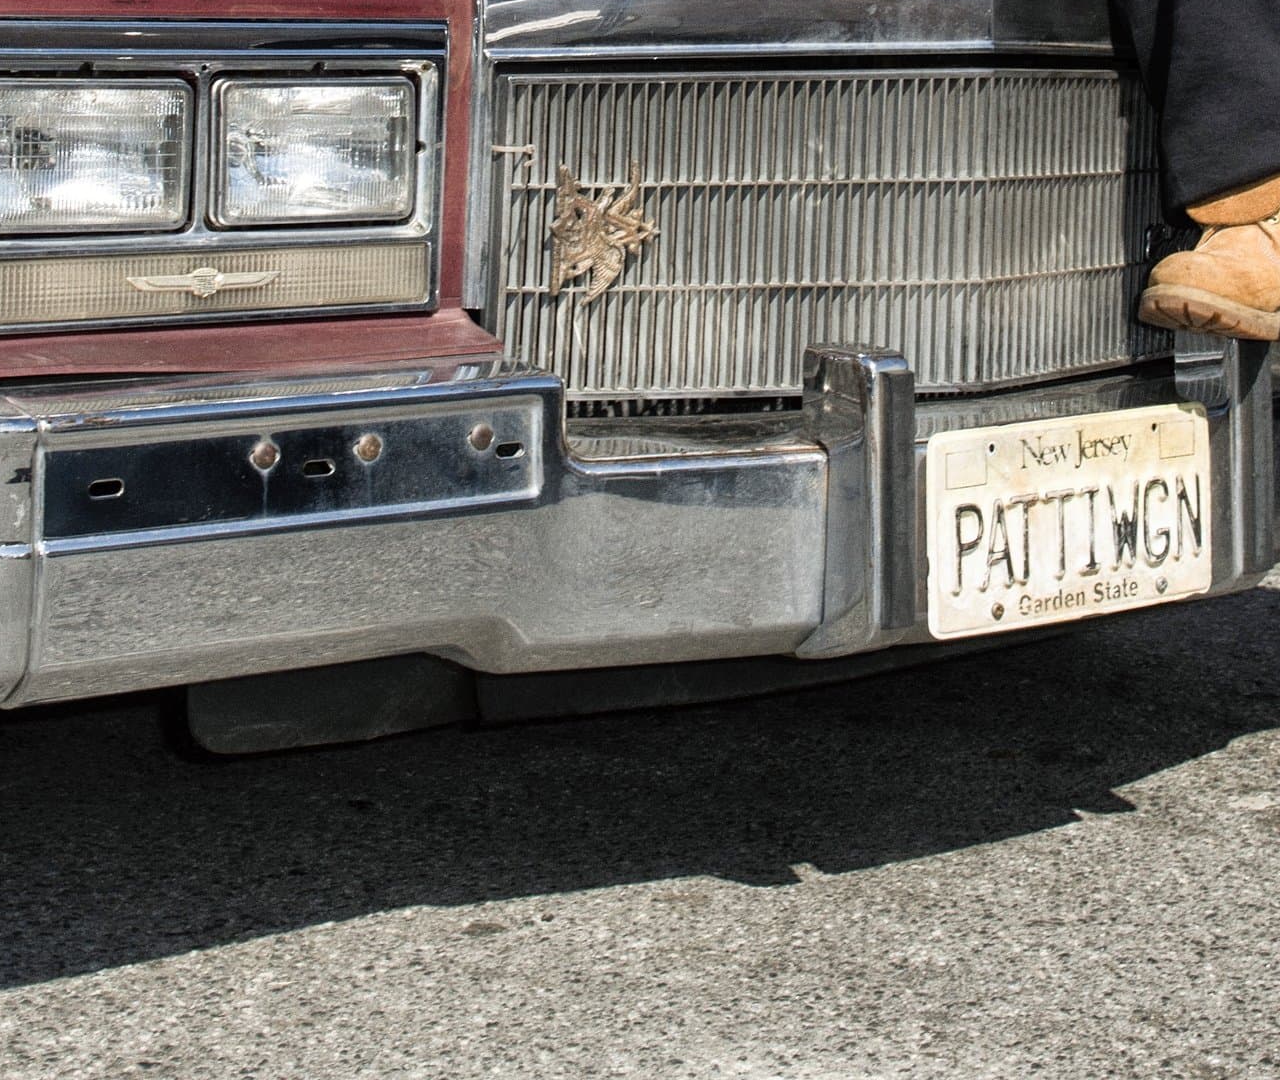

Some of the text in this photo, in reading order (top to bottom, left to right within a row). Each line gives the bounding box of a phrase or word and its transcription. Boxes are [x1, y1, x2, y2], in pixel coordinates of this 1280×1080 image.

[1020, 428, 1133, 469] New Jersey
[951, 473, 1204, 596] PATTIWGN
[1018, 579, 1139, 616] Garden State
